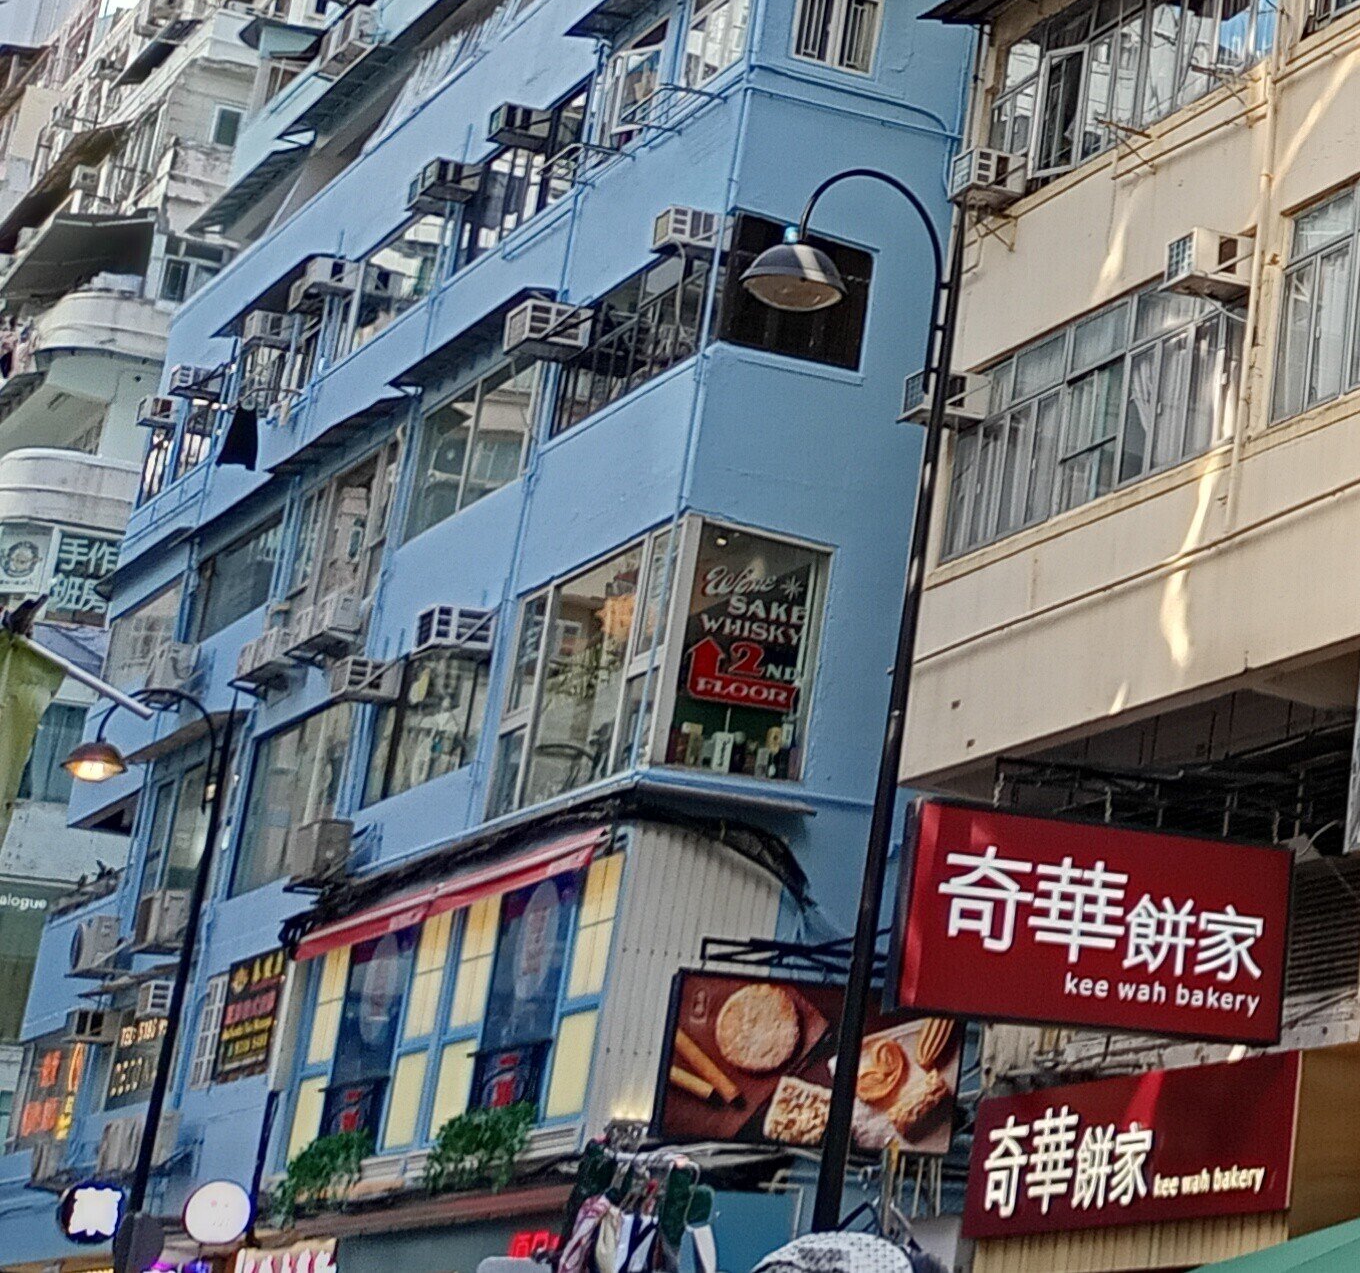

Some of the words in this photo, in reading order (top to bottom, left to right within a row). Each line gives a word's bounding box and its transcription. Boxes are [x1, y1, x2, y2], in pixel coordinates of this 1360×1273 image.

[60, 537, 119, 575] 手作
[728, 595, 807, 624] SAKE
[701, 613, 805, 646] WHISKY
[696, 677, 789, 704] FLOOR
[937, 846, 1265, 983] 奇華餅家
[1064, 971, 1109, 999] kee
[1118, 978, 1167, 1006] wah
[1175, 981, 1262, 1016] bakery
[983, 1104, 1154, 1221] 奇華餅家
[1153, 1175, 1181, 1202] kee
[1181, 1171, 1210, 1198] wah
[1211, 1162, 1267, 1194] bakery
